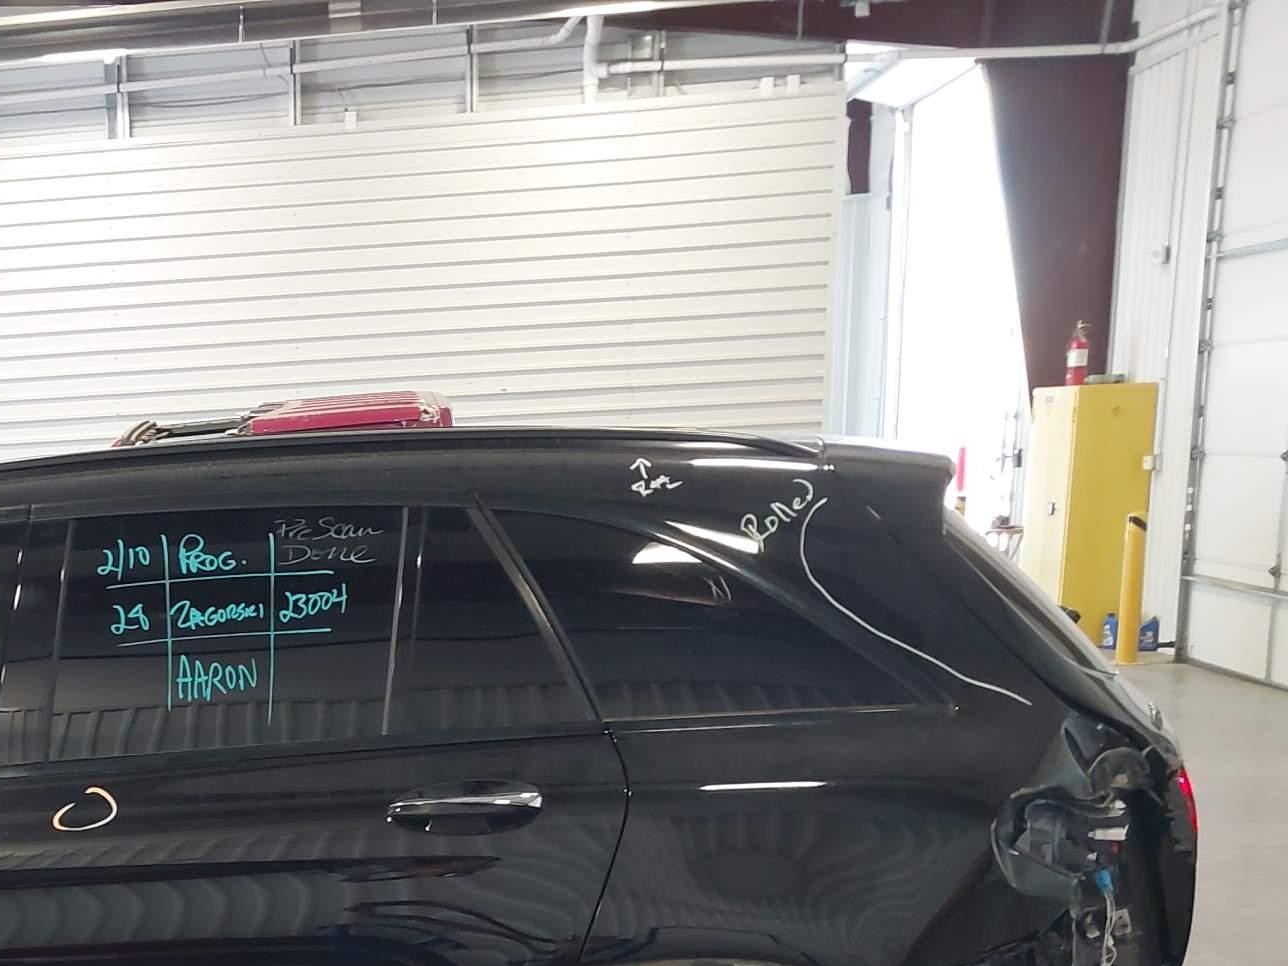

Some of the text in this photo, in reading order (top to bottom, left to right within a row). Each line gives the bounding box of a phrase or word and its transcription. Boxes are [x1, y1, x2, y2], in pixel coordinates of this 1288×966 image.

[312, 516, 385, 541] Scan
[278, 544, 377, 565] Done
[278, 583, 349, 623] 23004
[110, 604, 150, 635] 28
[176, 654, 258, 702] AARON
